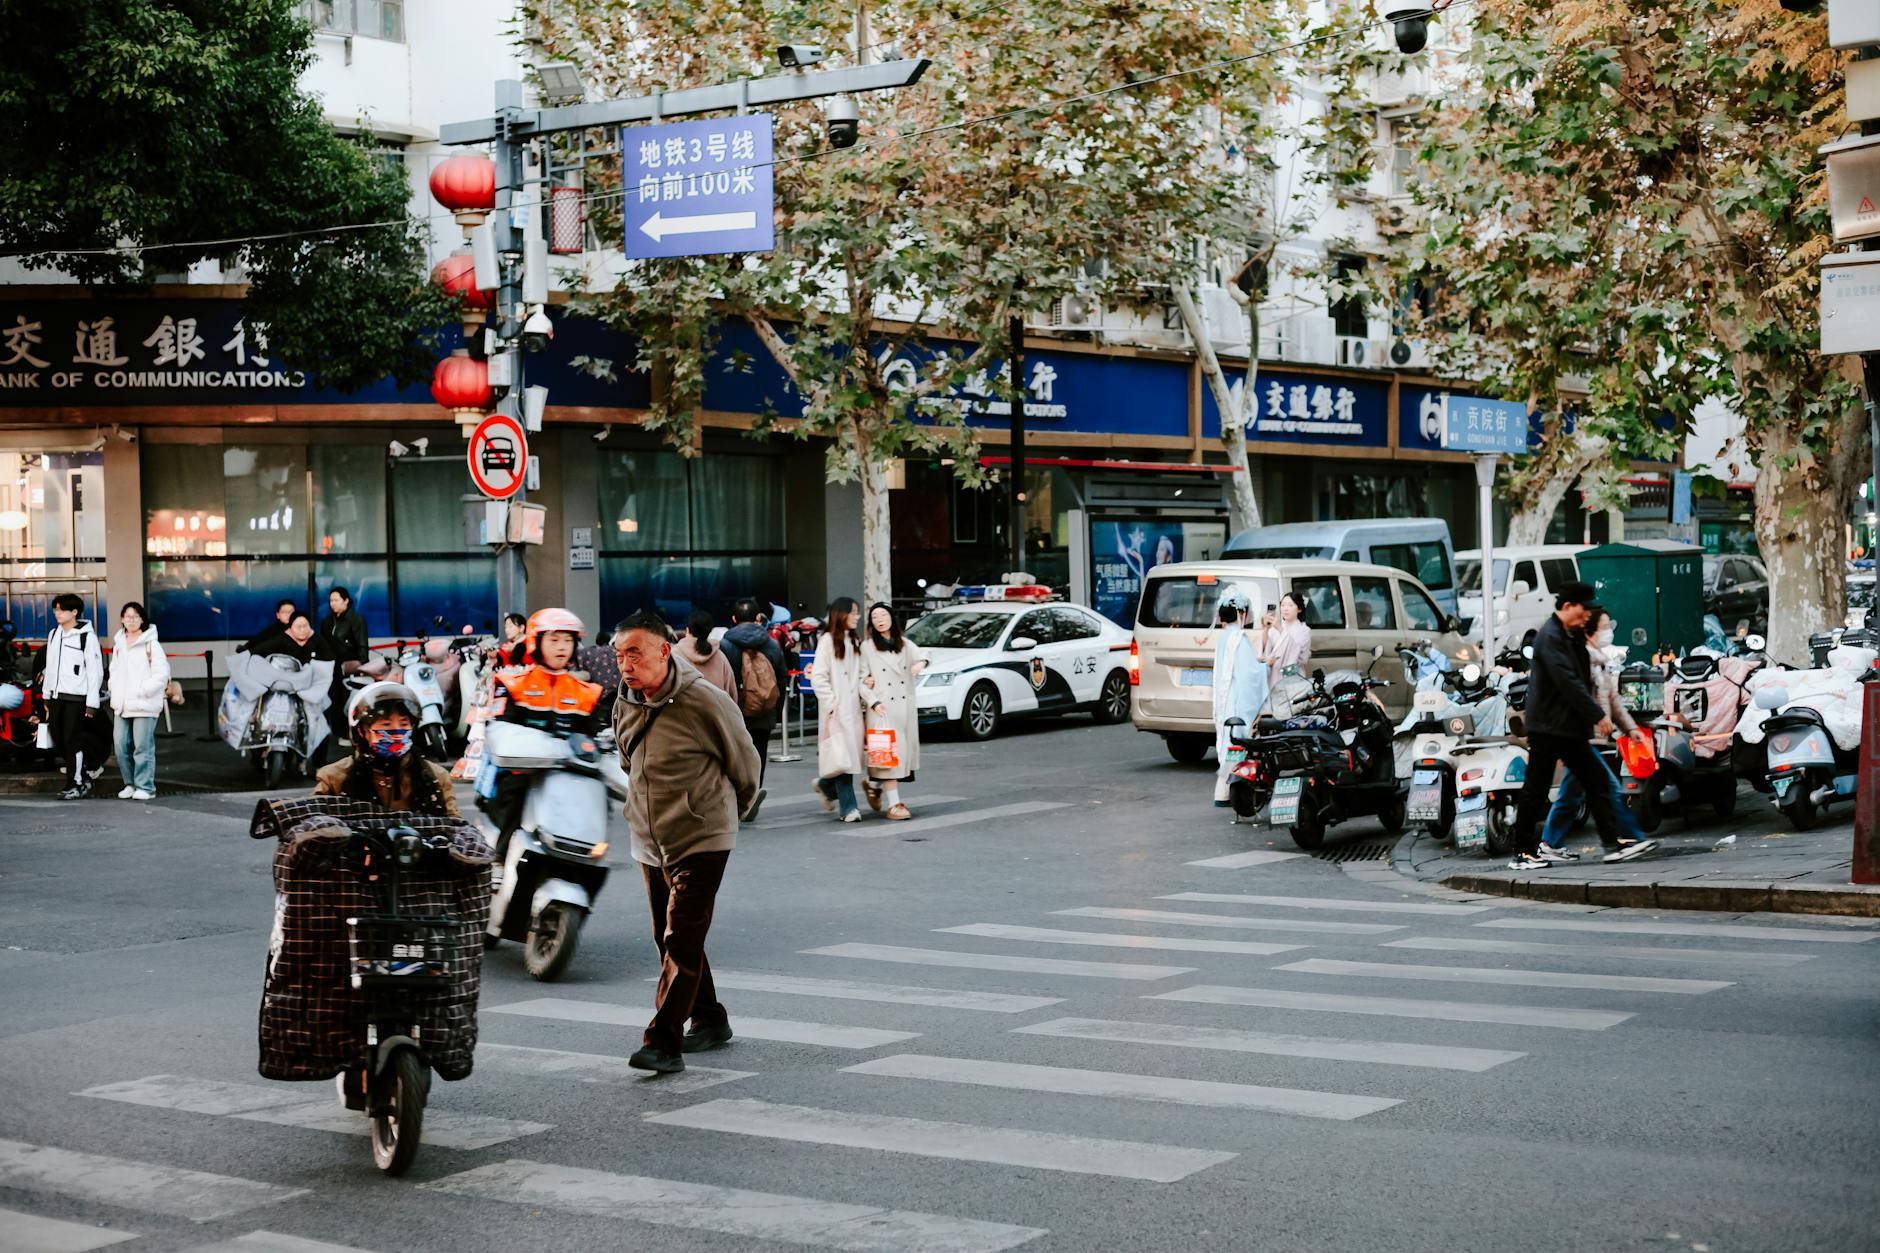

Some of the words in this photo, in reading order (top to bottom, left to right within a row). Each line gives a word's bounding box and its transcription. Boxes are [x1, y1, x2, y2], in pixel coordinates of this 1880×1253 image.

[640, 130, 755, 168] 地铁3号线
[639, 165, 755, 203] 向前100米
[51, 371, 84, 388] OF
[94, 371, 305, 388] COMMUNICATIONS
[1467, 406, 1507, 432] 贡院街
[1073, 655, 1097, 675] 公安
